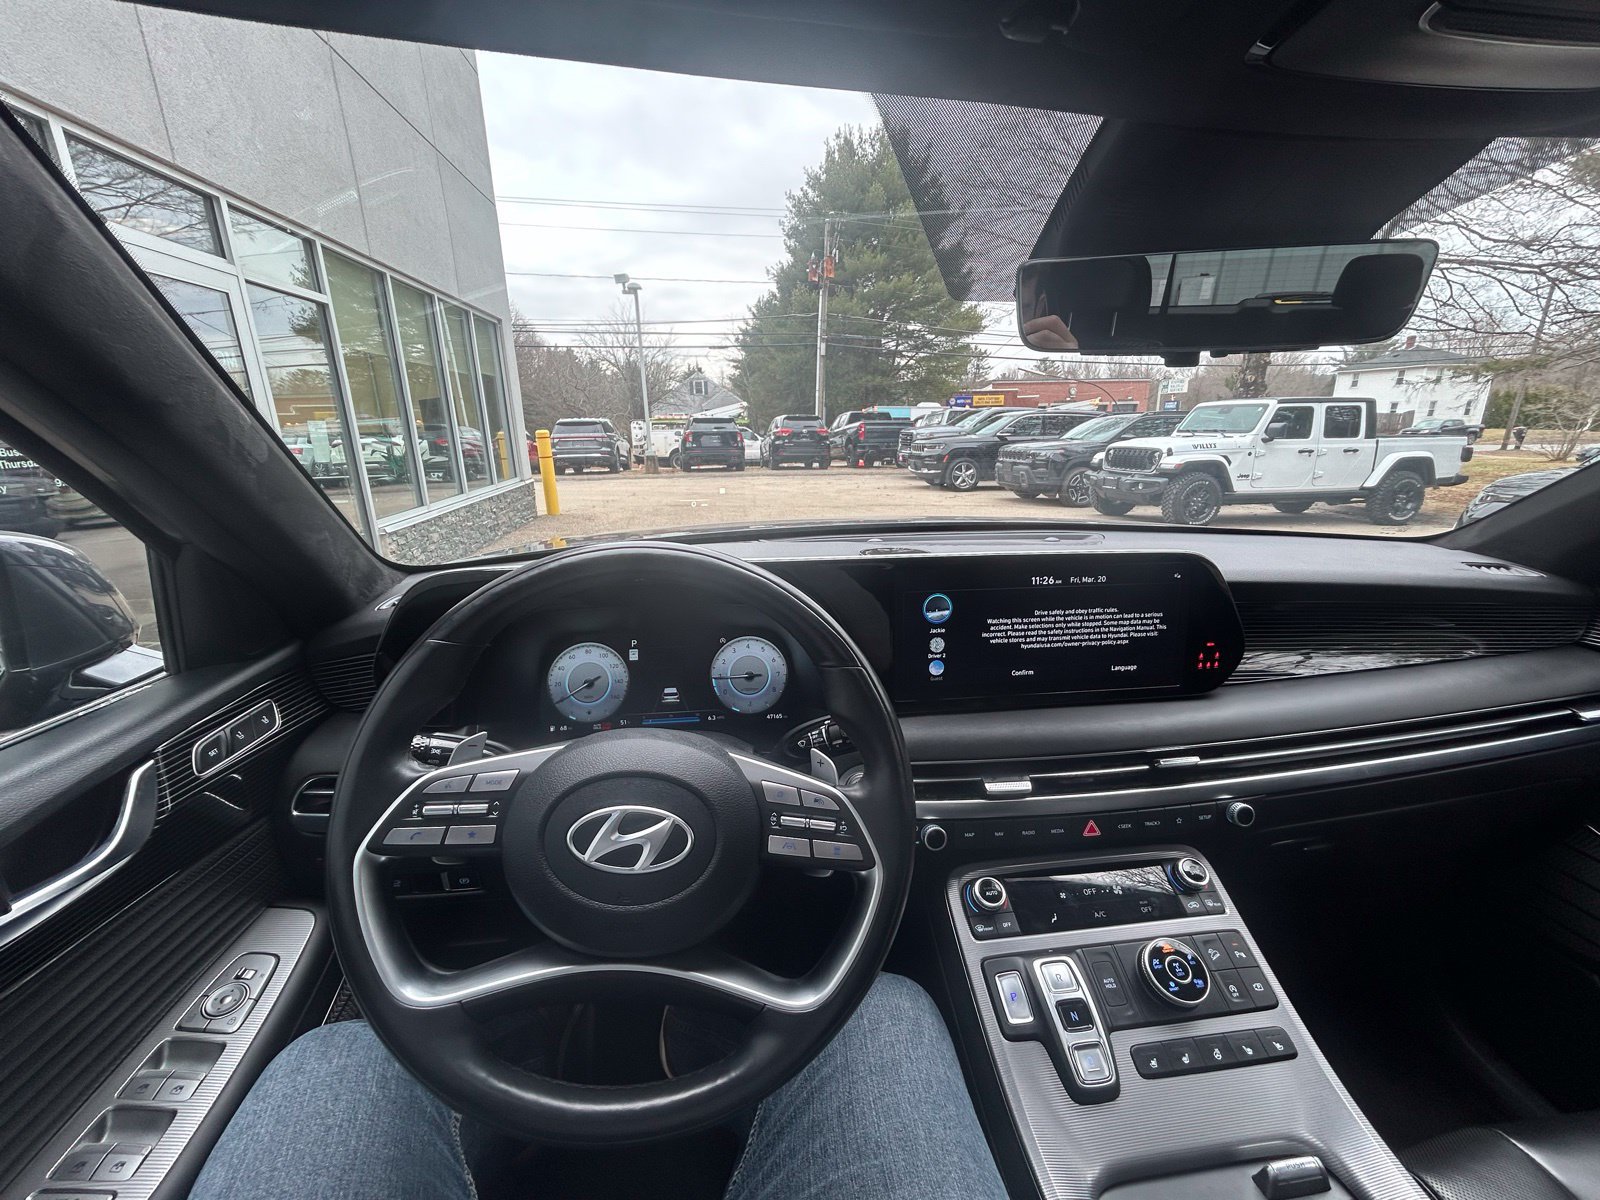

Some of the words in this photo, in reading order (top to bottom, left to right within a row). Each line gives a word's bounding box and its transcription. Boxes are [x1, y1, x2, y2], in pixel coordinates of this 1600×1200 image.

[1032, 576, 1054, 585] 11:26
[1021, 640, 1129, 650] hyundaiusa.com/owner-privacy-policy.aspx
[208, 748, 219, 757] SET
[1083, 888, 1096, 896] OFF
[1010, 992, 1017, 1001] P
[1070, 1011, 1079, 1021] N
[1087, 1056, 1094, 1065] D
